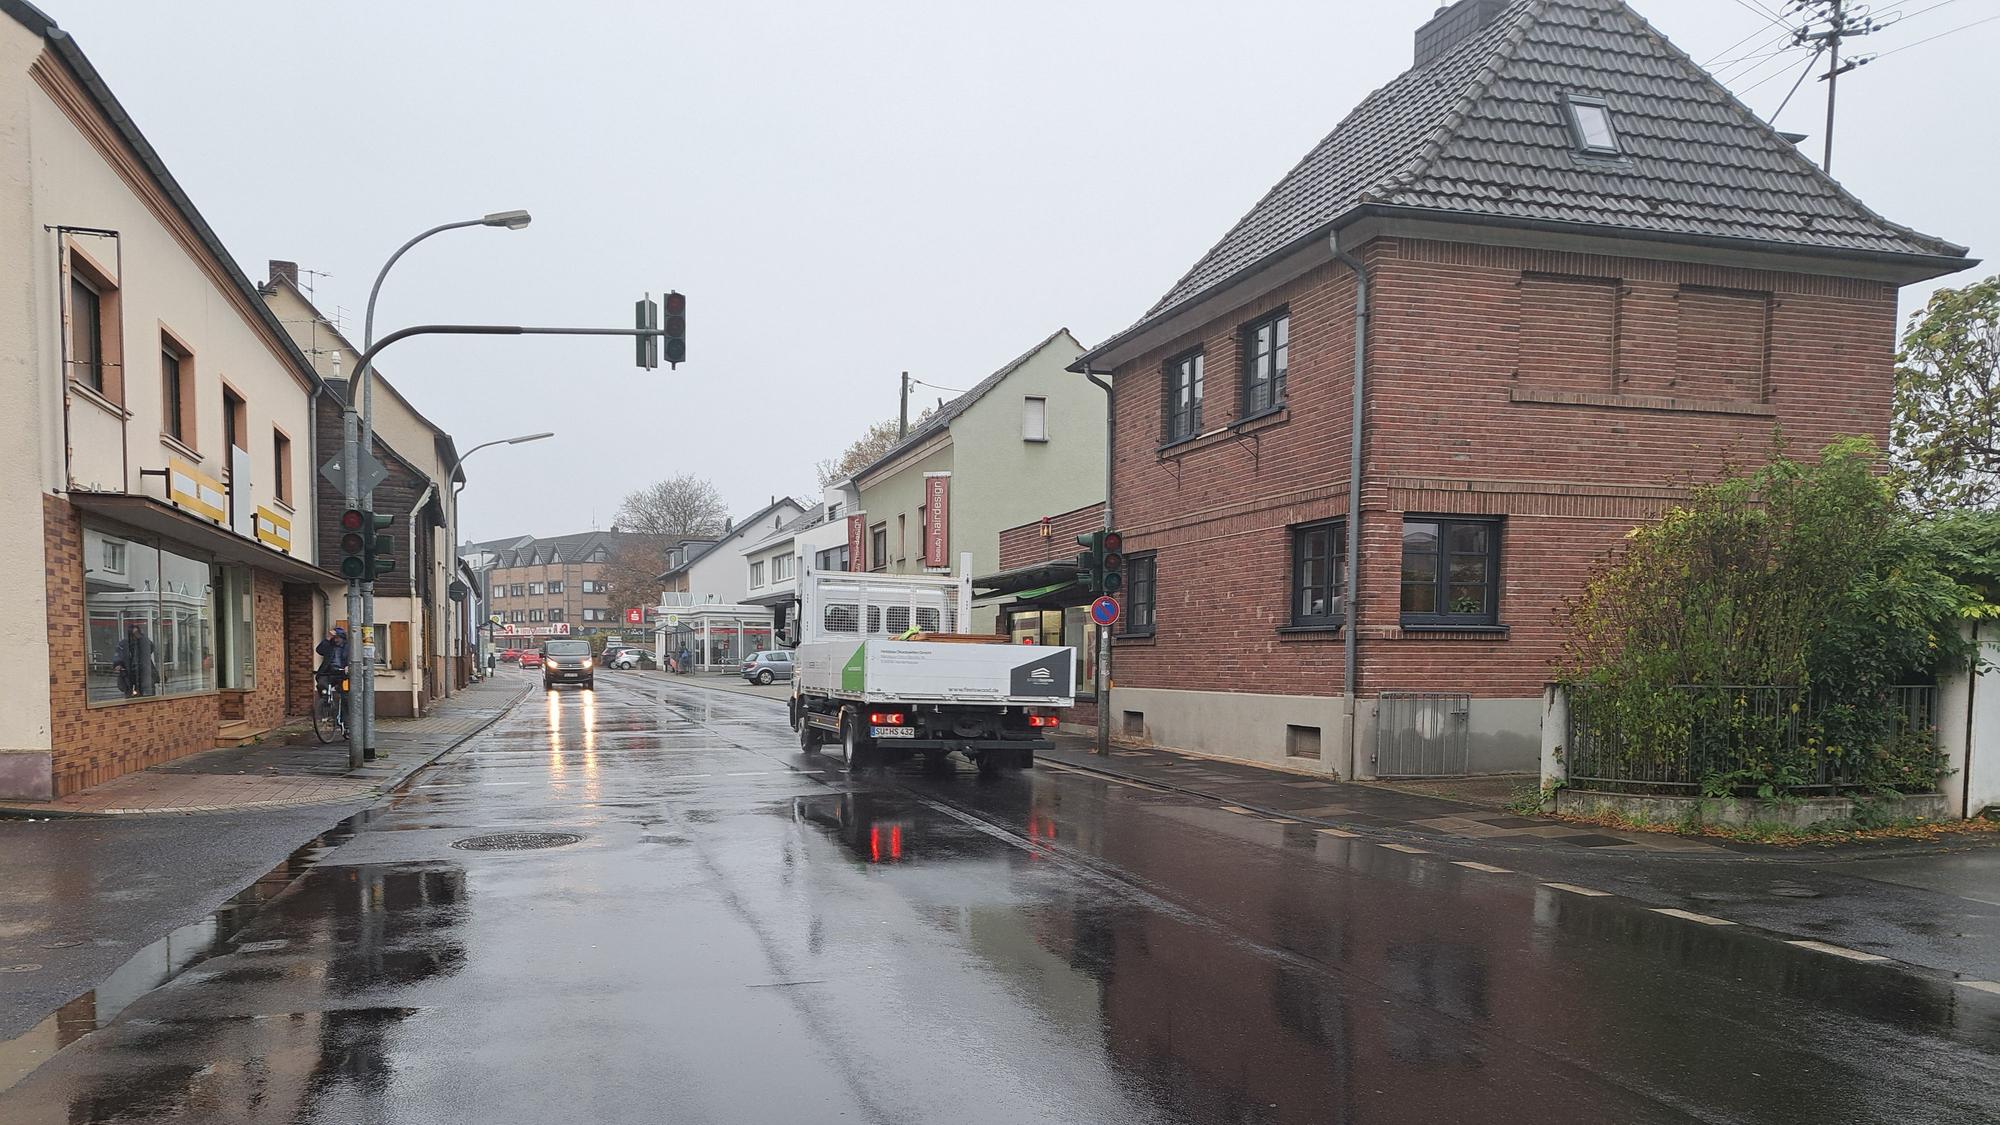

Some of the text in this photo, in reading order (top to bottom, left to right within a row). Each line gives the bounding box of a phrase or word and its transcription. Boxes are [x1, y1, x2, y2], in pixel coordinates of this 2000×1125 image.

[932, 481, 943, 536] hairdesign
[875, 727, 885, 735] SU
[900, 728, 914, 736] 432
